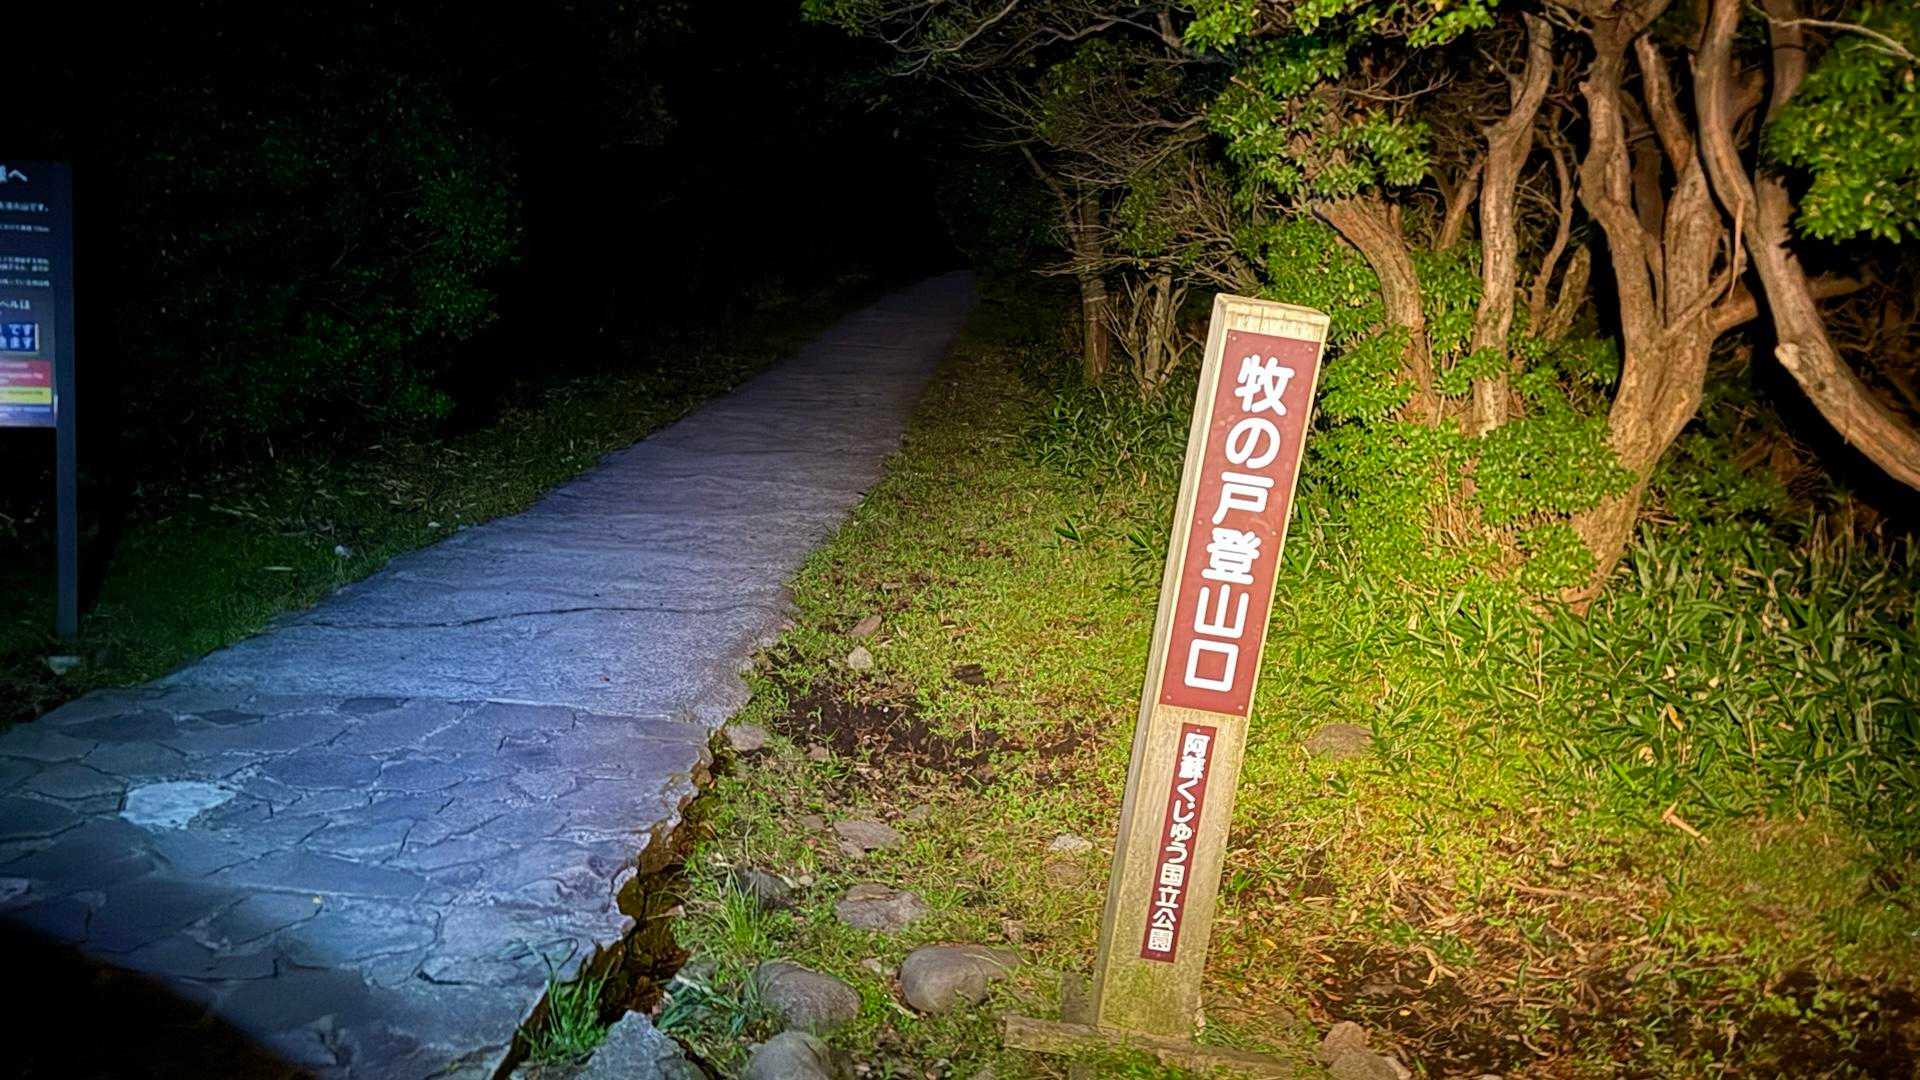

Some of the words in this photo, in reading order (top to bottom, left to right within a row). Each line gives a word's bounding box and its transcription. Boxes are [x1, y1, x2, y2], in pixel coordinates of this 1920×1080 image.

[1184, 354, 1296, 693] 牧の戸登山口
[1148, 732, 1210, 953] 阿蘇くじゅう国立公園
